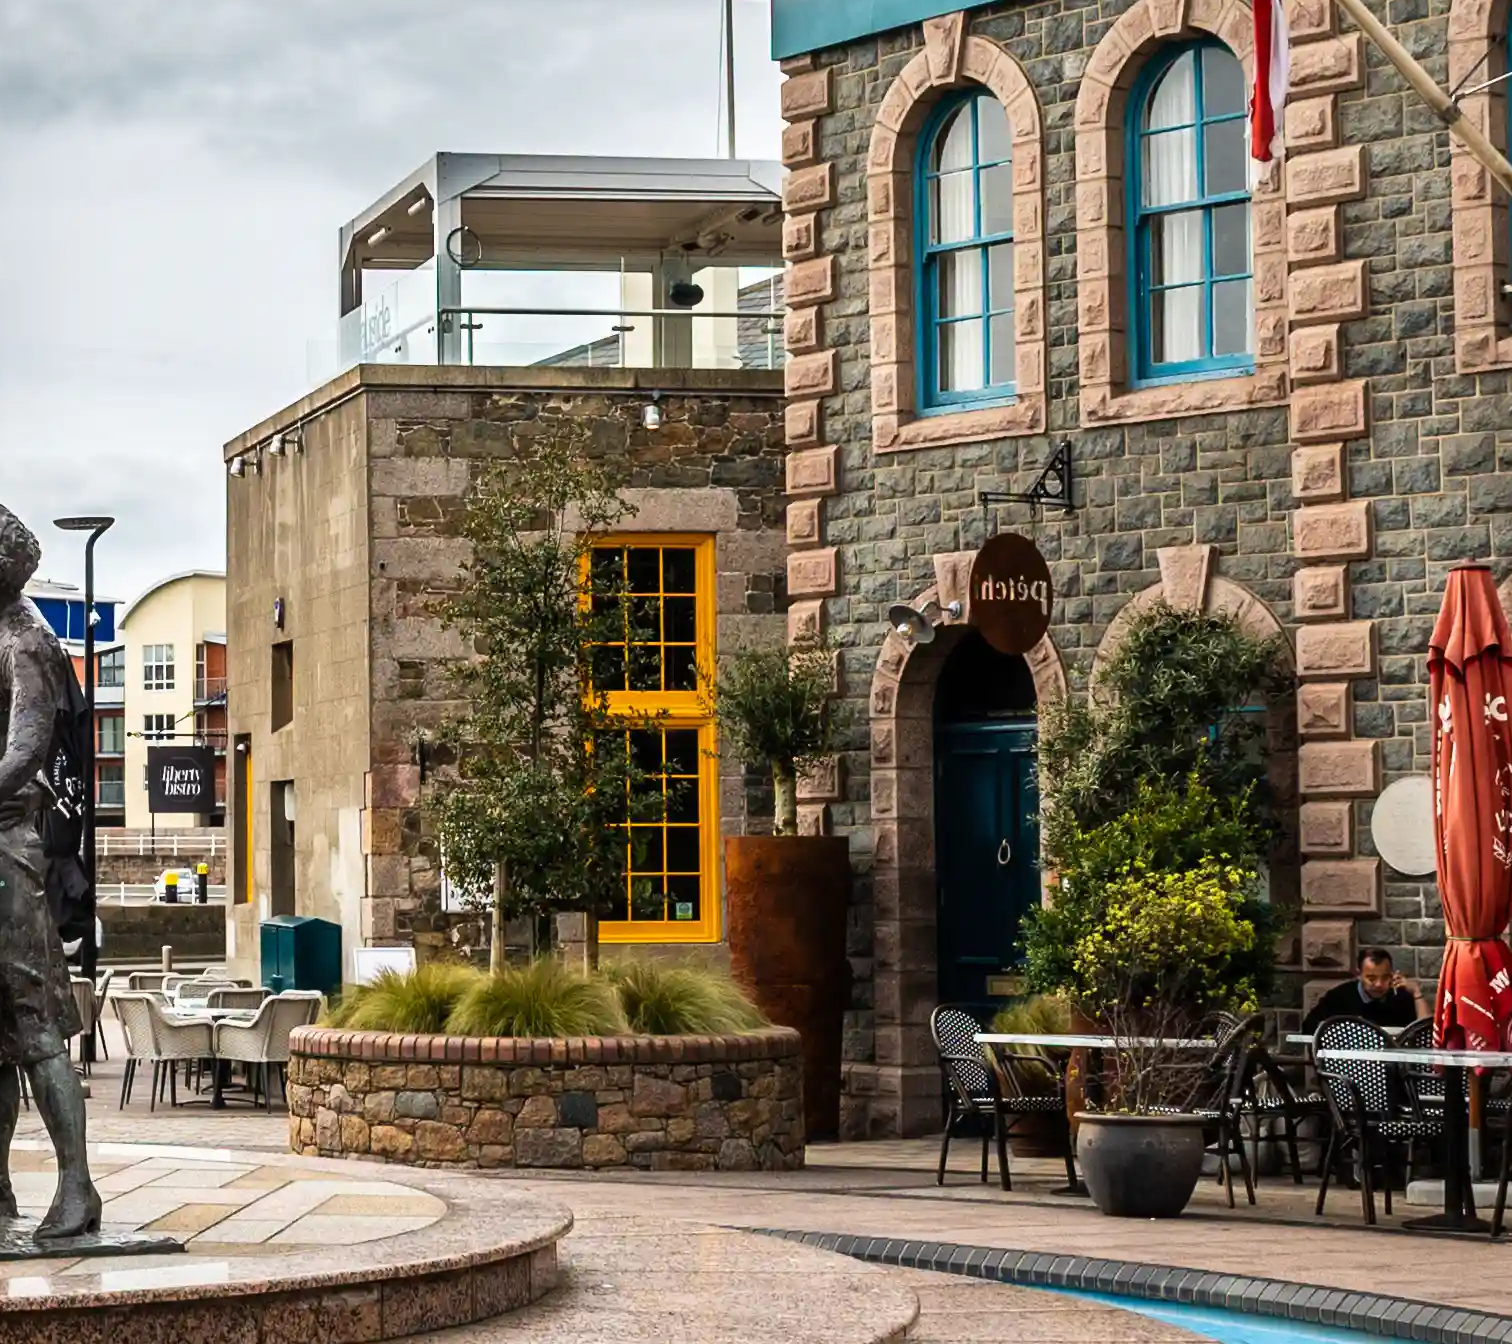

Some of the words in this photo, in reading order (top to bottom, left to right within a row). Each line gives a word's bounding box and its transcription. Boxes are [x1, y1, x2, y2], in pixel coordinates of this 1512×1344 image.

[53, 755, 62, 786] FAMILY
[162, 765, 200, 782] liberty
[165, 777, 201, 795] bistro
